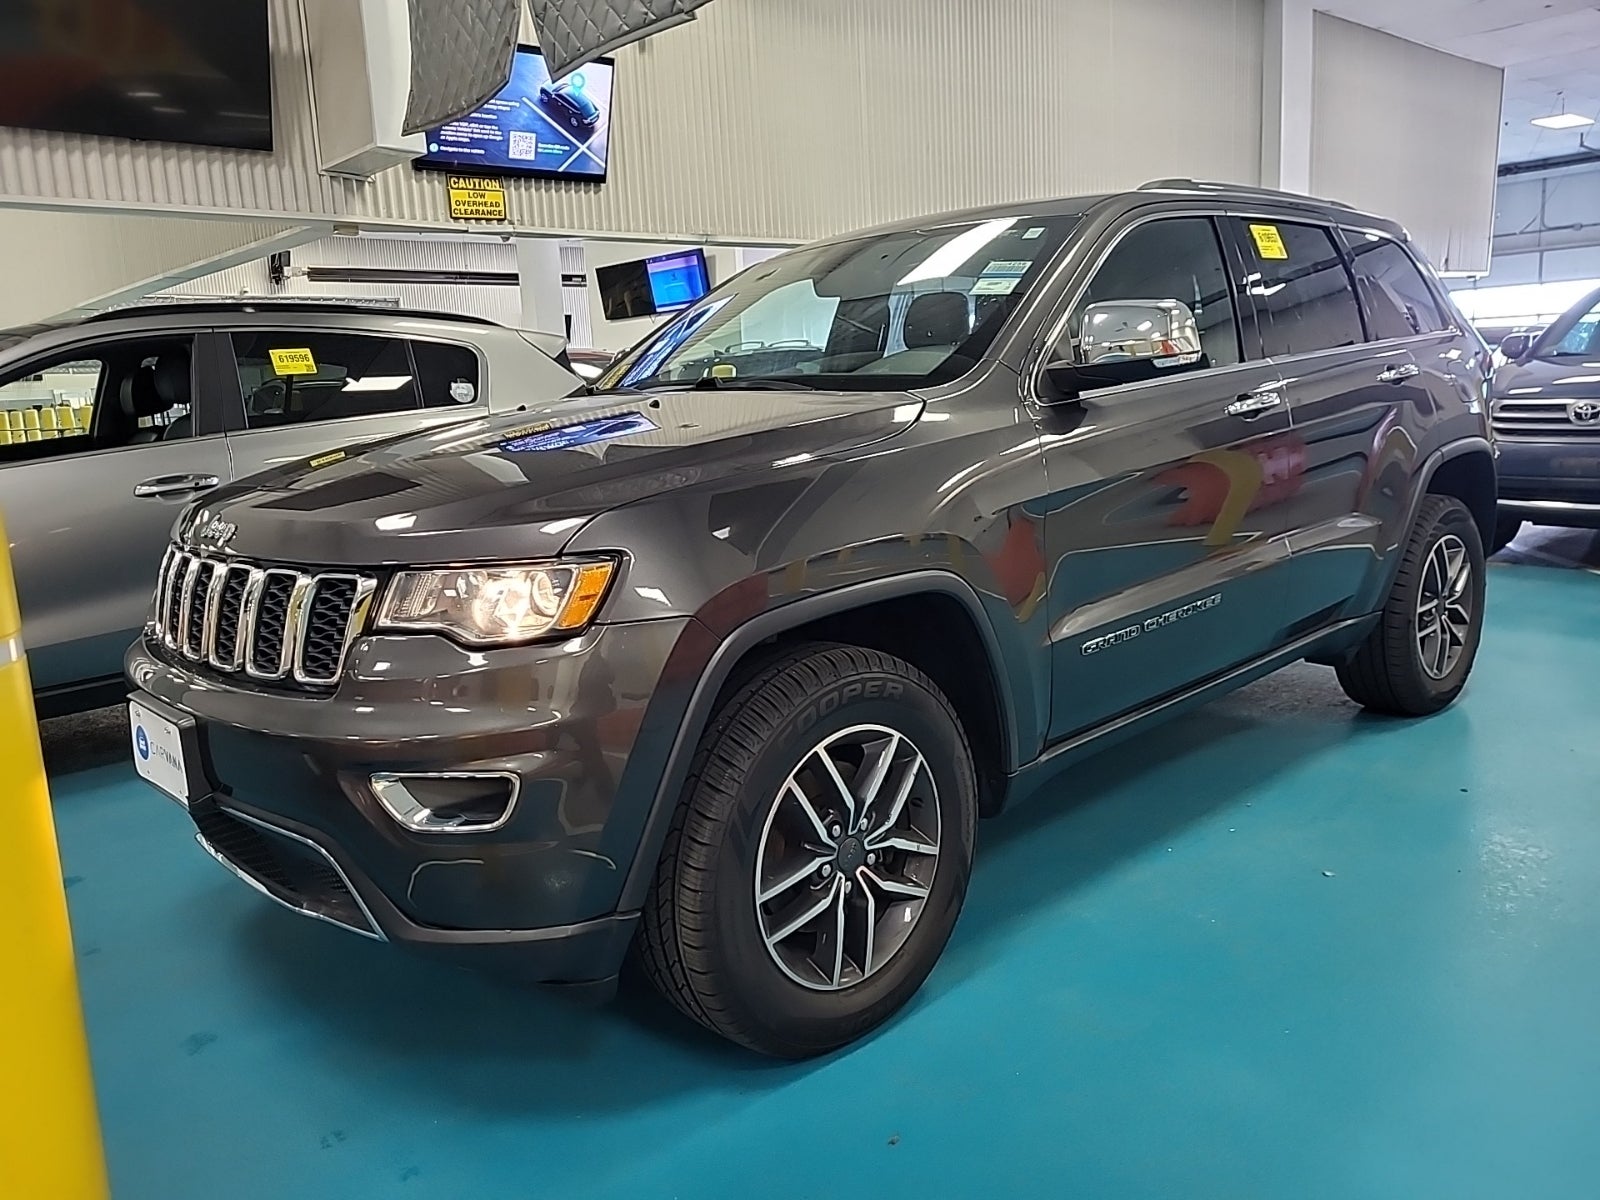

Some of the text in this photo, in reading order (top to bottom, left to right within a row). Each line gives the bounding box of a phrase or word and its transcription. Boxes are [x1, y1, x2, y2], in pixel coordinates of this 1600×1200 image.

[450, 177, 501, 189] CAUTION
[454, 199, 501, 208] OVERHEAD
[453, 207, 503, 216] CLEARANCE
[278, 353, 310, 363] 619596
[1081, 593, 1222, 656] GRAND CHEROKEE
